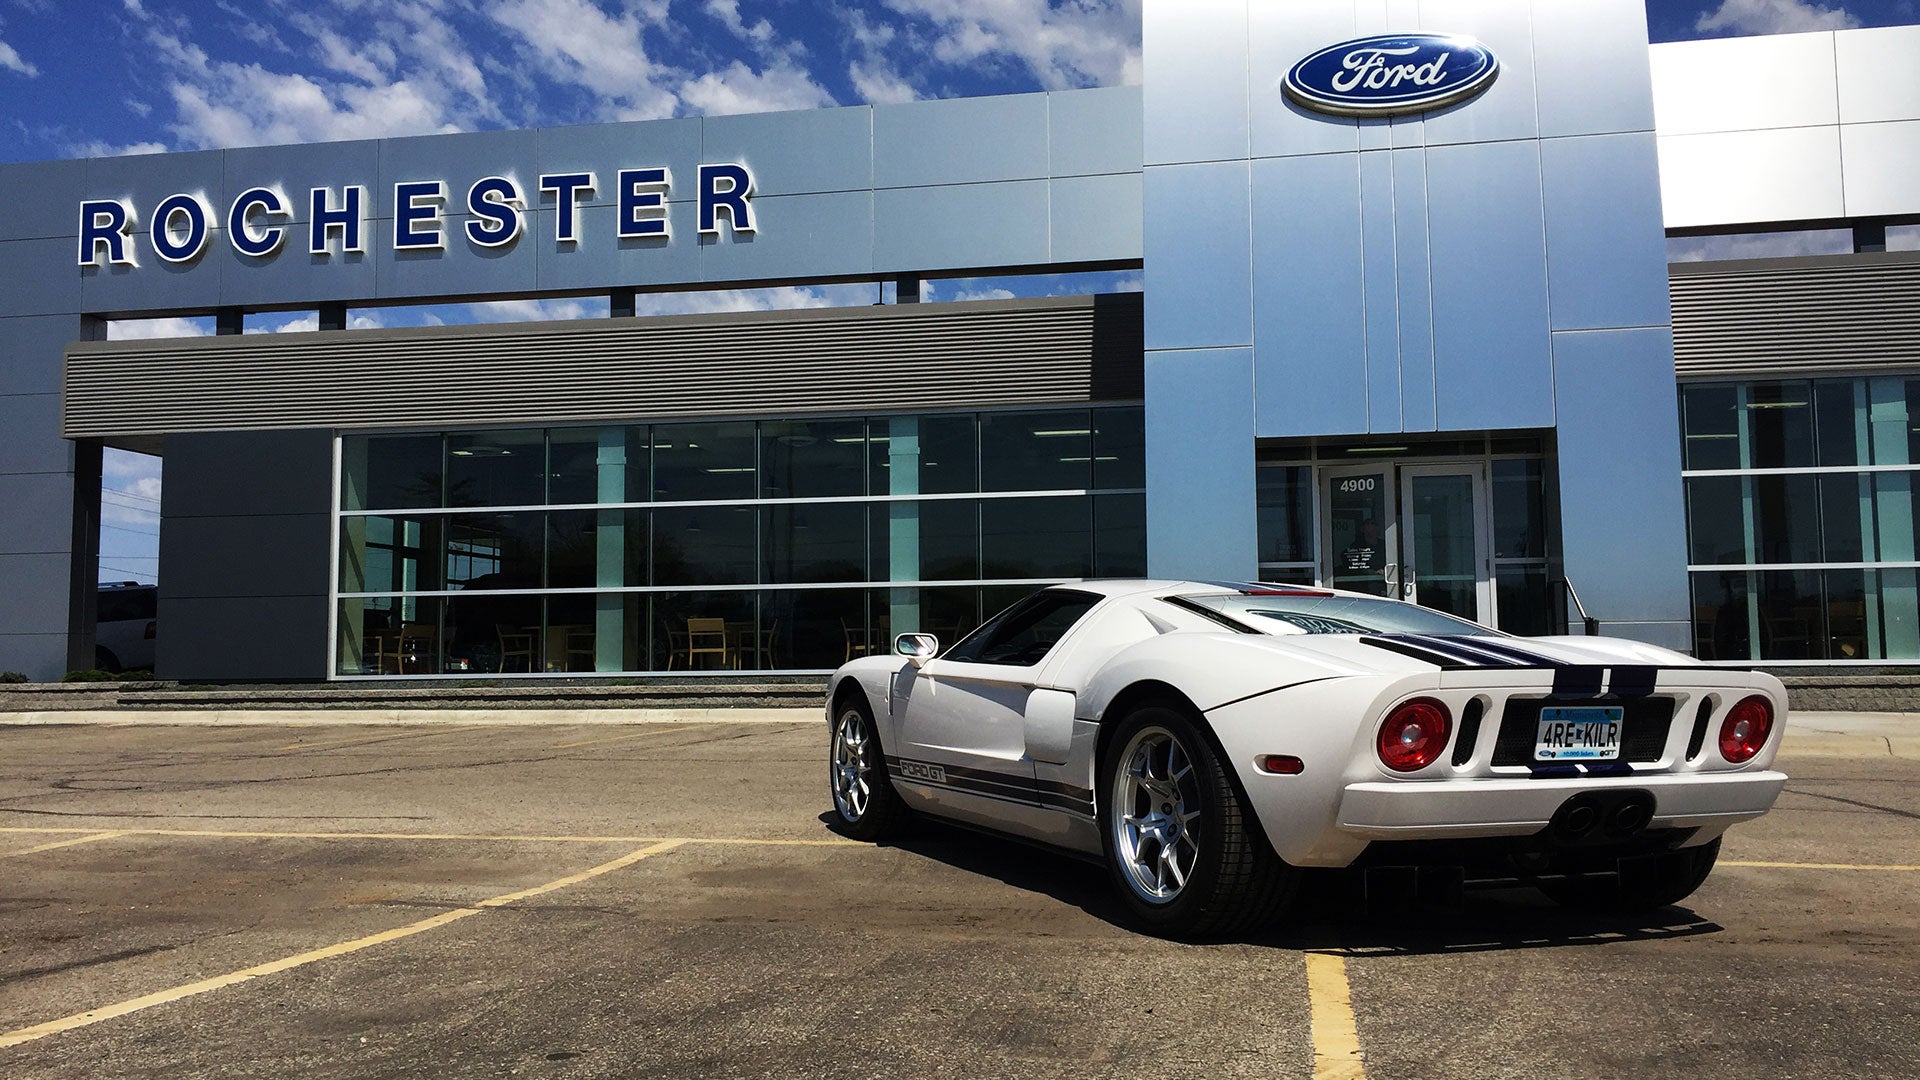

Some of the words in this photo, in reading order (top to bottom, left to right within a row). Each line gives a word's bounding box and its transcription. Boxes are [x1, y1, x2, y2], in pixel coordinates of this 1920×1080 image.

[1332, 46, 1449, 92] Ford
[78, 162, 760, 266] ROCHESTER
[1340, 478, 1375, 492] 4900
[1543, 723, 1575, 748] 4RE
[1583, 723, 1617, 748] KILR
[901, 761, 930, 778] FORD
[929, 766, 943, 780] GT
